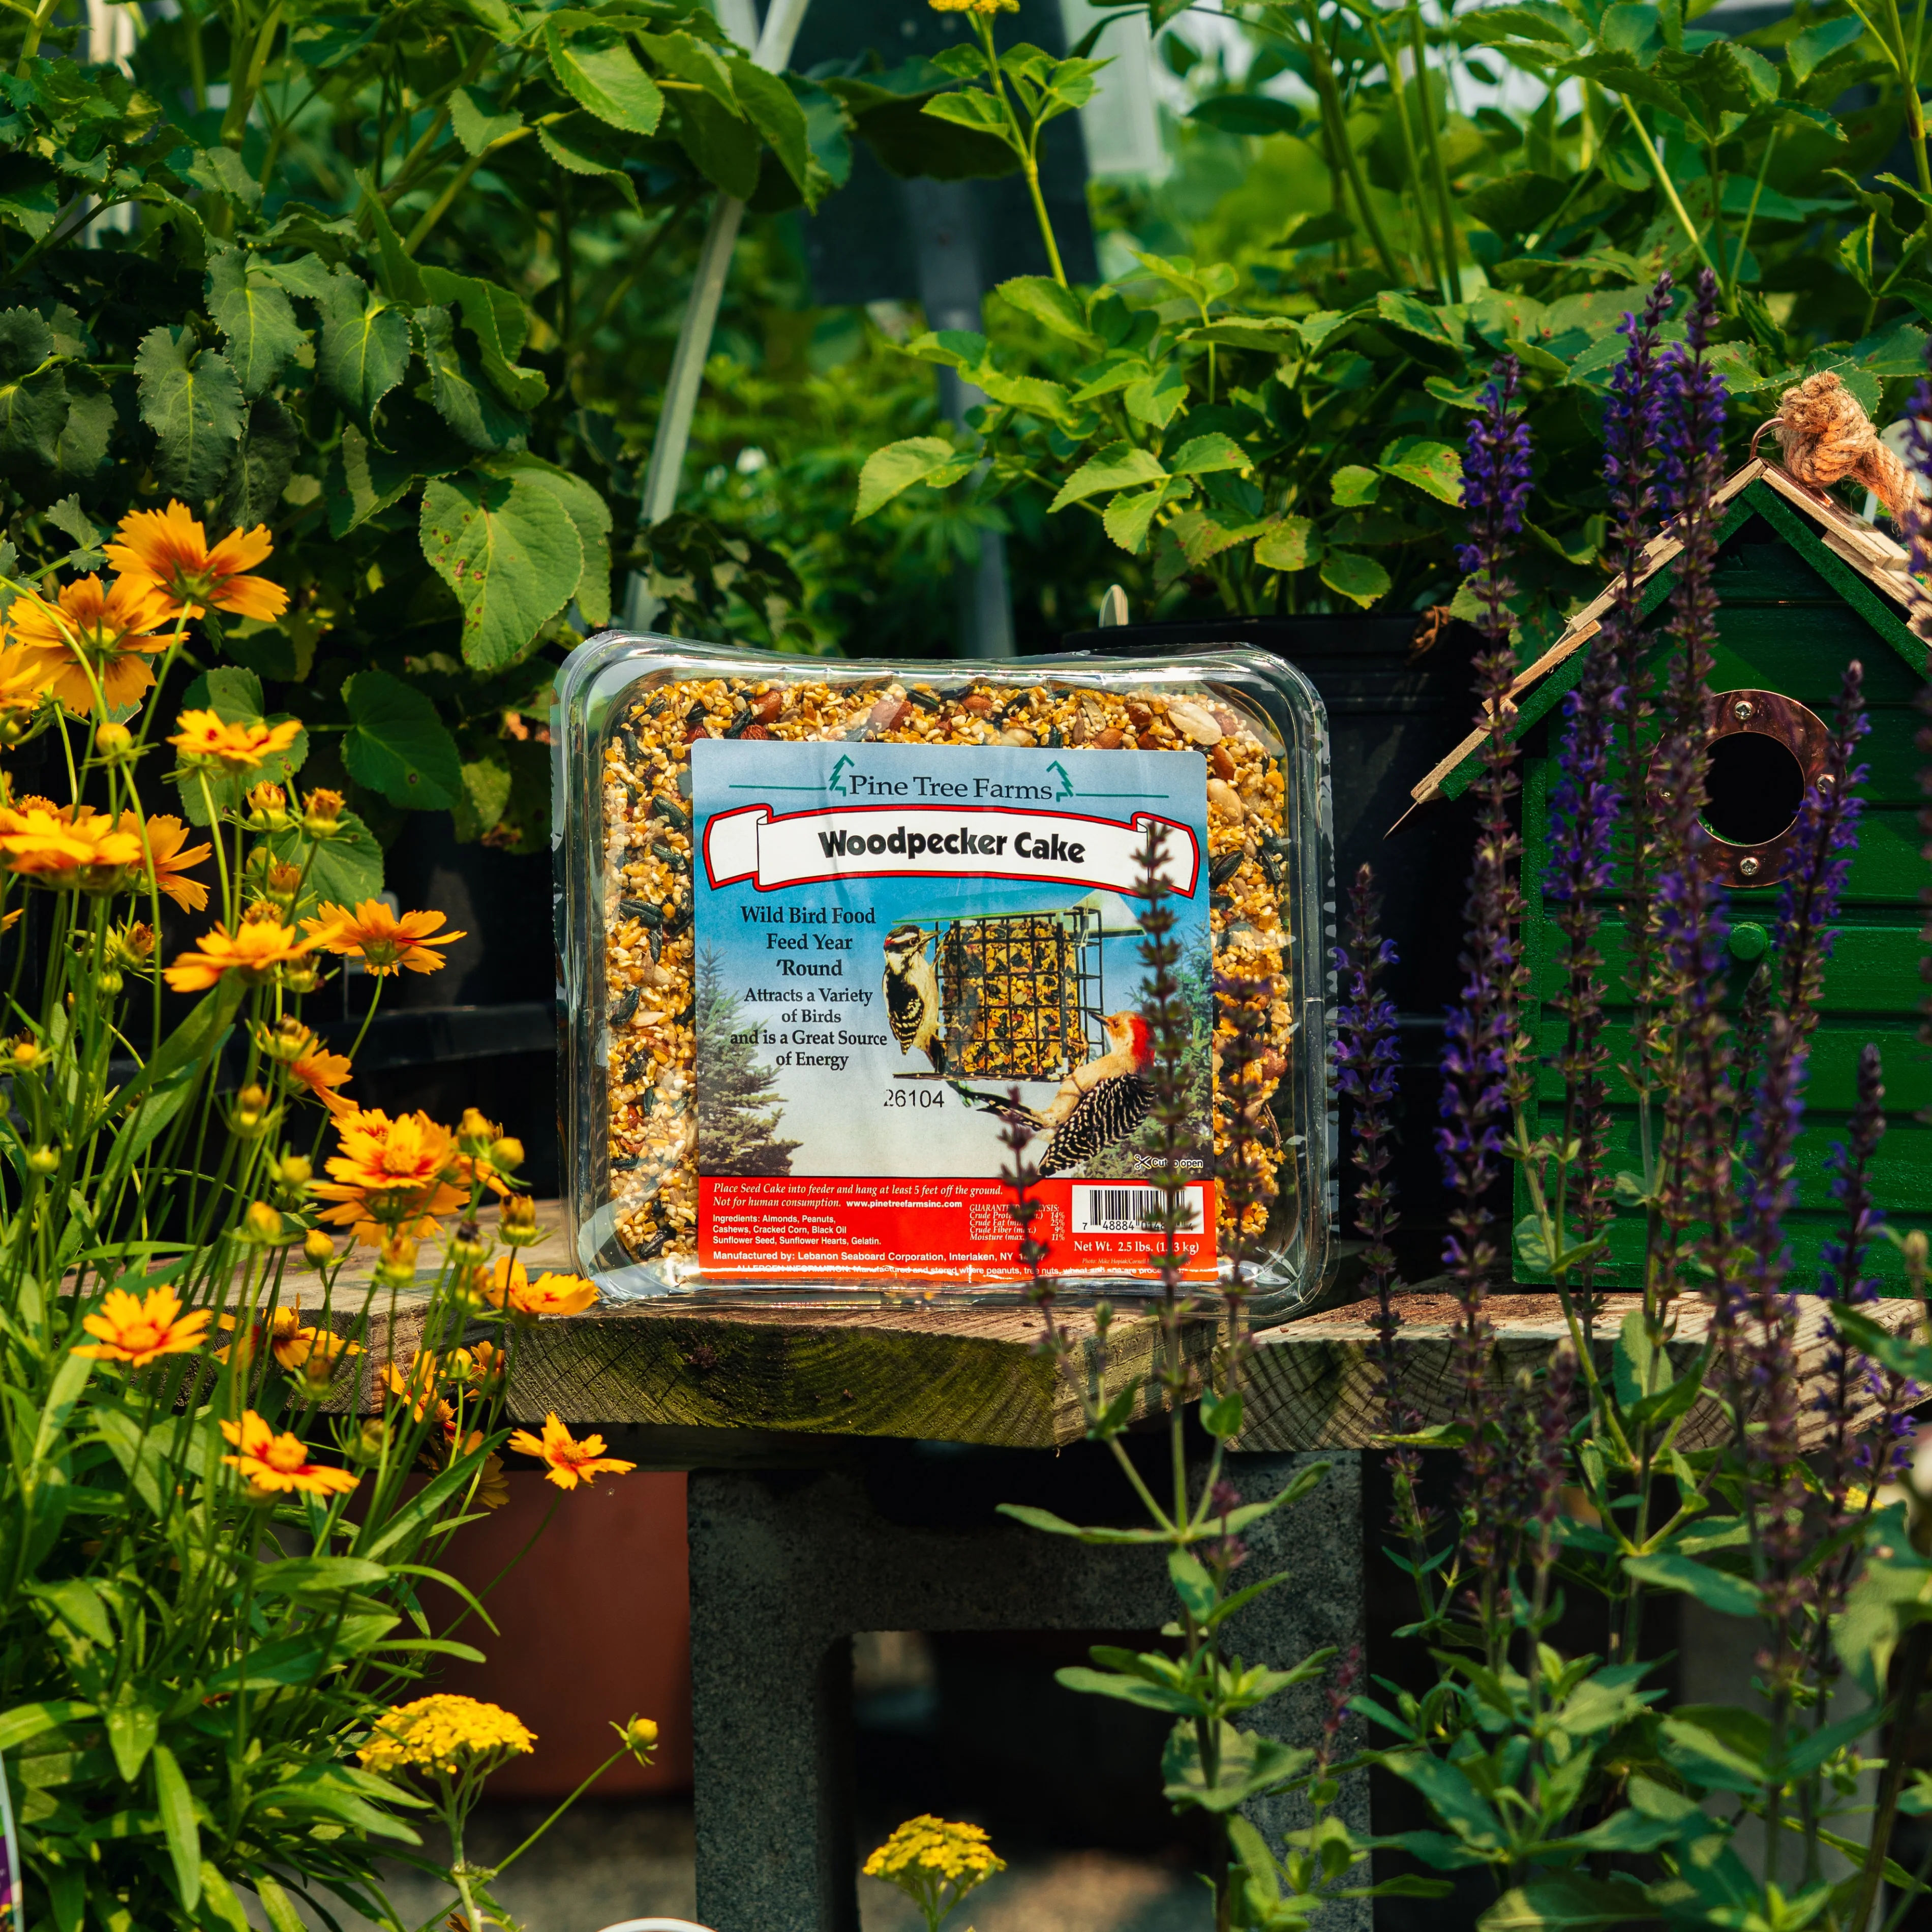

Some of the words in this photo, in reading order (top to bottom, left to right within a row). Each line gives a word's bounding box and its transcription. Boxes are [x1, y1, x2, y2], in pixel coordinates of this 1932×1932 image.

[849, 775, 908, 796] Pine
[913, 776, 968, 798] Tree
[974, 778, 1052, 800] Farms
[818, 826, 1008, 860] Woodpecker
[1014, 831, 1086, 864] Cake
[740, 905, 784, 923] Wild
[788, 907, 828, 924] Bird
[831, 907, 877, 924] Food
[766, 933, 809, 950] Feed
[812, 933, 853, 950] Year
[776, 959, 843, 976] 'Round
[743, 987, 803, 1002] Attracts
[806, 991, 816, 1002] a
[818, 987, 873, 1007] Variety
[781, 1008, 798, 1022] of
[801, 1009, 841, 1023] Birds
[730, 1030, 758, 1045] and
[763, 1029, 776, 1044] is
[779, 1034, 789, 1044] a
[792, 1030, 835, 1045] Great
[838, 1030, 887, 1046] Source
[776, 1051, 792, 1066] of
[795, 1051, 850, 1071] Energy
[883, 1089, 945, 1108] 26104
[1151, 1158, 1168, 1167] Cut
[1180, 1160, 1203, 1169] open
[713, 1183, 738, 1193] Place
[740, 1183, 761, 1193] Seed
[763, 1183, 786, 1193] Cake
[788, 1184, 806, 1193] into
[807, 1183, 835, 1196] feeder
[836, 1184, 854, 1194] and
[855, 1184, 878, 1197] hang
[880, 1185, 890, 1194] at
[892, 1184, 913, 1194] least
[914, 1185, 919, 1194] 5
[920, 1185, 939, 1197] feet
[940, 1185, 954, 1197] off
[955, 1185, 969, 1195] the
[970, 1185, 1003, 1198] ground.
[713, 1196, 731, 1206] Not
[731, 1196, 746, 1209] for
[748, 1196, 779, 1206] human
[781, 1197, 841, 1210] consumption.
[846, 1199, 962, 1209] www.pinetreefarmsinc.com
[713, 1214, 760, 1224] Ingredients:
[762, 1214, 800, 1224] Almonds,
[802, 1215, 836, 1224] Peanuts,
[1082, 1222, 1088, 1230] 7
[1102, 1221, 1135, 1230] 48884
[1141, 1221, 1173, 1230] 0148
[712, 1225, 751, 1234] Cashews,
[753, 1225, 786, 1233] Cracked
[788, 1225, 809, 1234] Corn,
[811, 1225, 834, 1234] Black
[835, 1225, 847, 1234] Oil
[713, 1235, 753, 1244] Sunflower
[755, 1235, 777, 1245] Seed,
[779, 1236, 819, 1245] Sunflower
[821, 1236, 849, 1246] Hearts,
[851, 1236, 881, 1245] Gelatin.
[1074, 1241, 1093, 1251] Net
[1095, 1241, 1112, 1252] Wt.
[1118, 1242, 1132, 1252] 2.5
[1135, 1241, 1153, 1252] lbs.
[1156, 1242, 1180, 1253] (1.3
[1182, 1242, 1199, 1255] kg)
[713, 1251, 778, 1260] Manufactured
[780, 1251, 795, 1262] by:
[798, 1251, 838, 1260] Lebanon
[841, 1251, 885, 1261] Seaboard
[888, 1252, 946, 1262] Corporation,
[949, 1252, 998, 1262] Interlaken,
[1000, 1252, 1013, 1261] NY
[986, 1267, 1021, 1275] peanuts,
[1042, 1267, 1061, 1275] nuts,
